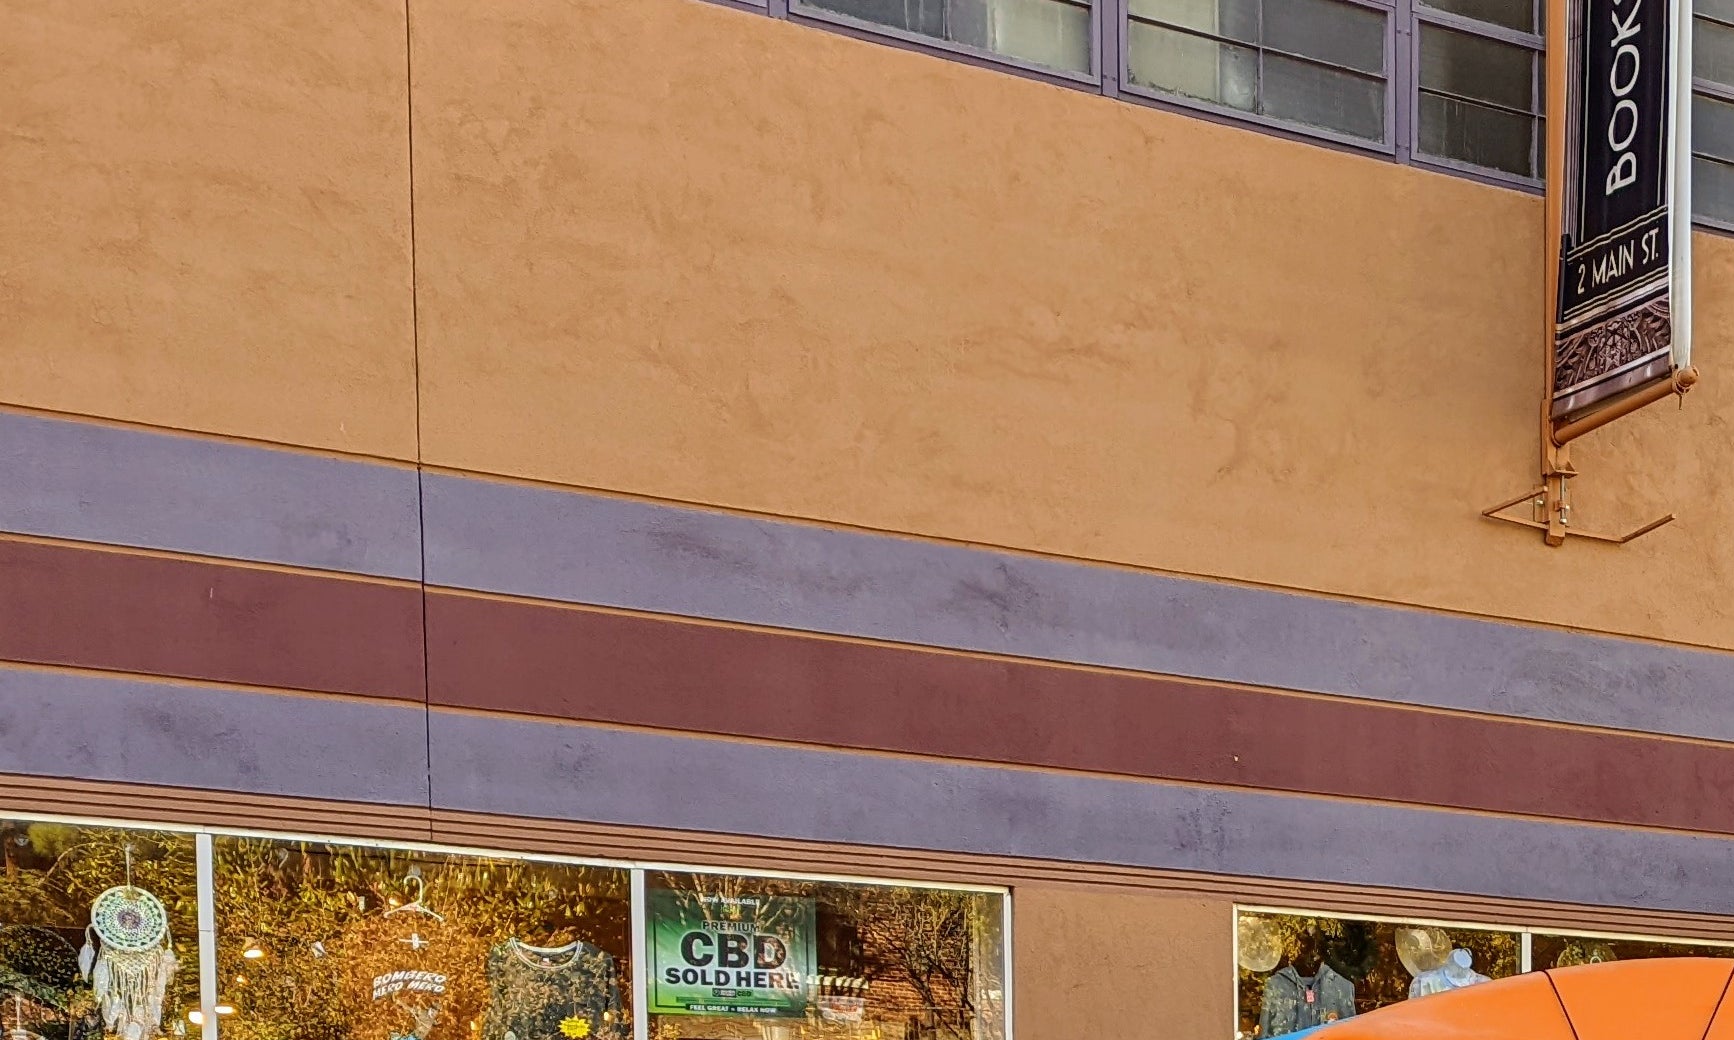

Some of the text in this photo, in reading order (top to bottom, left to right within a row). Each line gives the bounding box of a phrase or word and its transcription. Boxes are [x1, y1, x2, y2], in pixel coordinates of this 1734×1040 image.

[1606, 0, 1642, 196] BOOK
[1577, 227, 1660, 295] 2 MAIN ST.
[702, 921, 760, 932] PREMIUM
[680, 931, 787, 970] CBD
[665, 967, 800, 990] SOLD HERE
